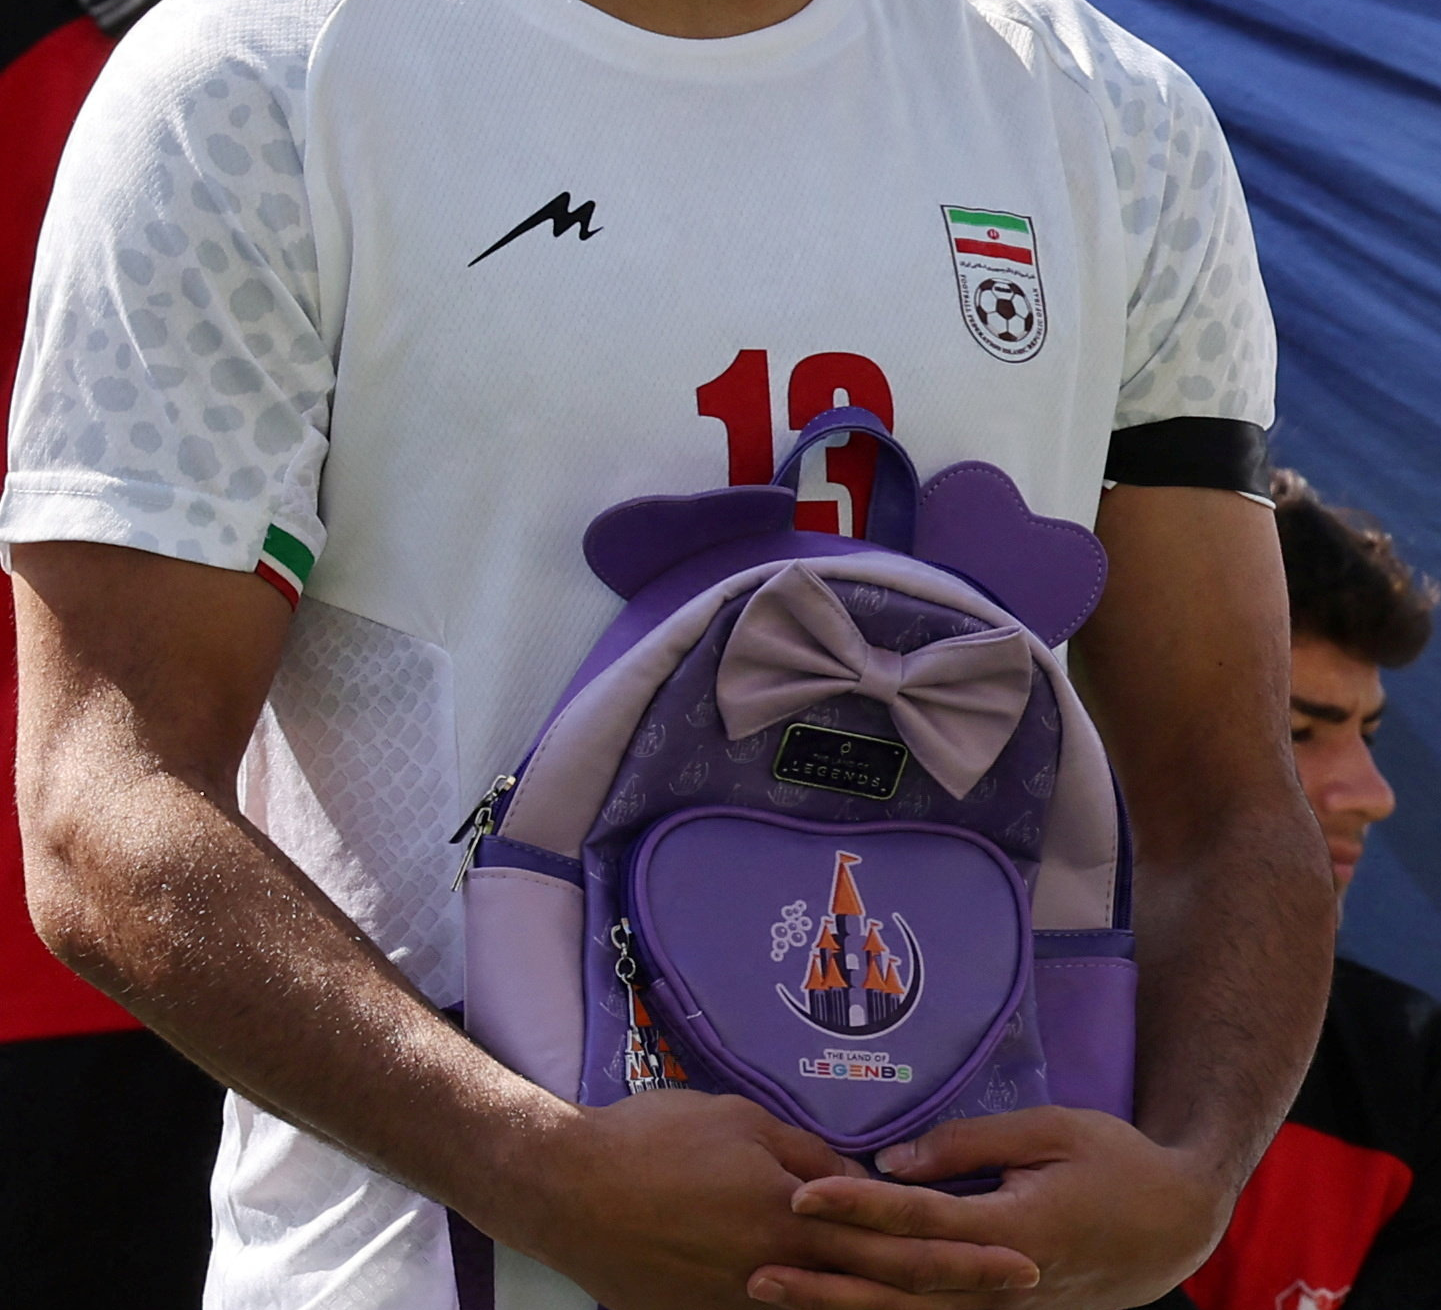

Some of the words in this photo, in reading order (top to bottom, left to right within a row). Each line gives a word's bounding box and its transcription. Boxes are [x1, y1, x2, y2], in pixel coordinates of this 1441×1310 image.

[827, 1052, 843, 1060] THE
[847, 1052, 872, 1062] LAND
[874, 1054, 887, 1063] OF
[802, 1060, 911, 1081] LEGENDS
